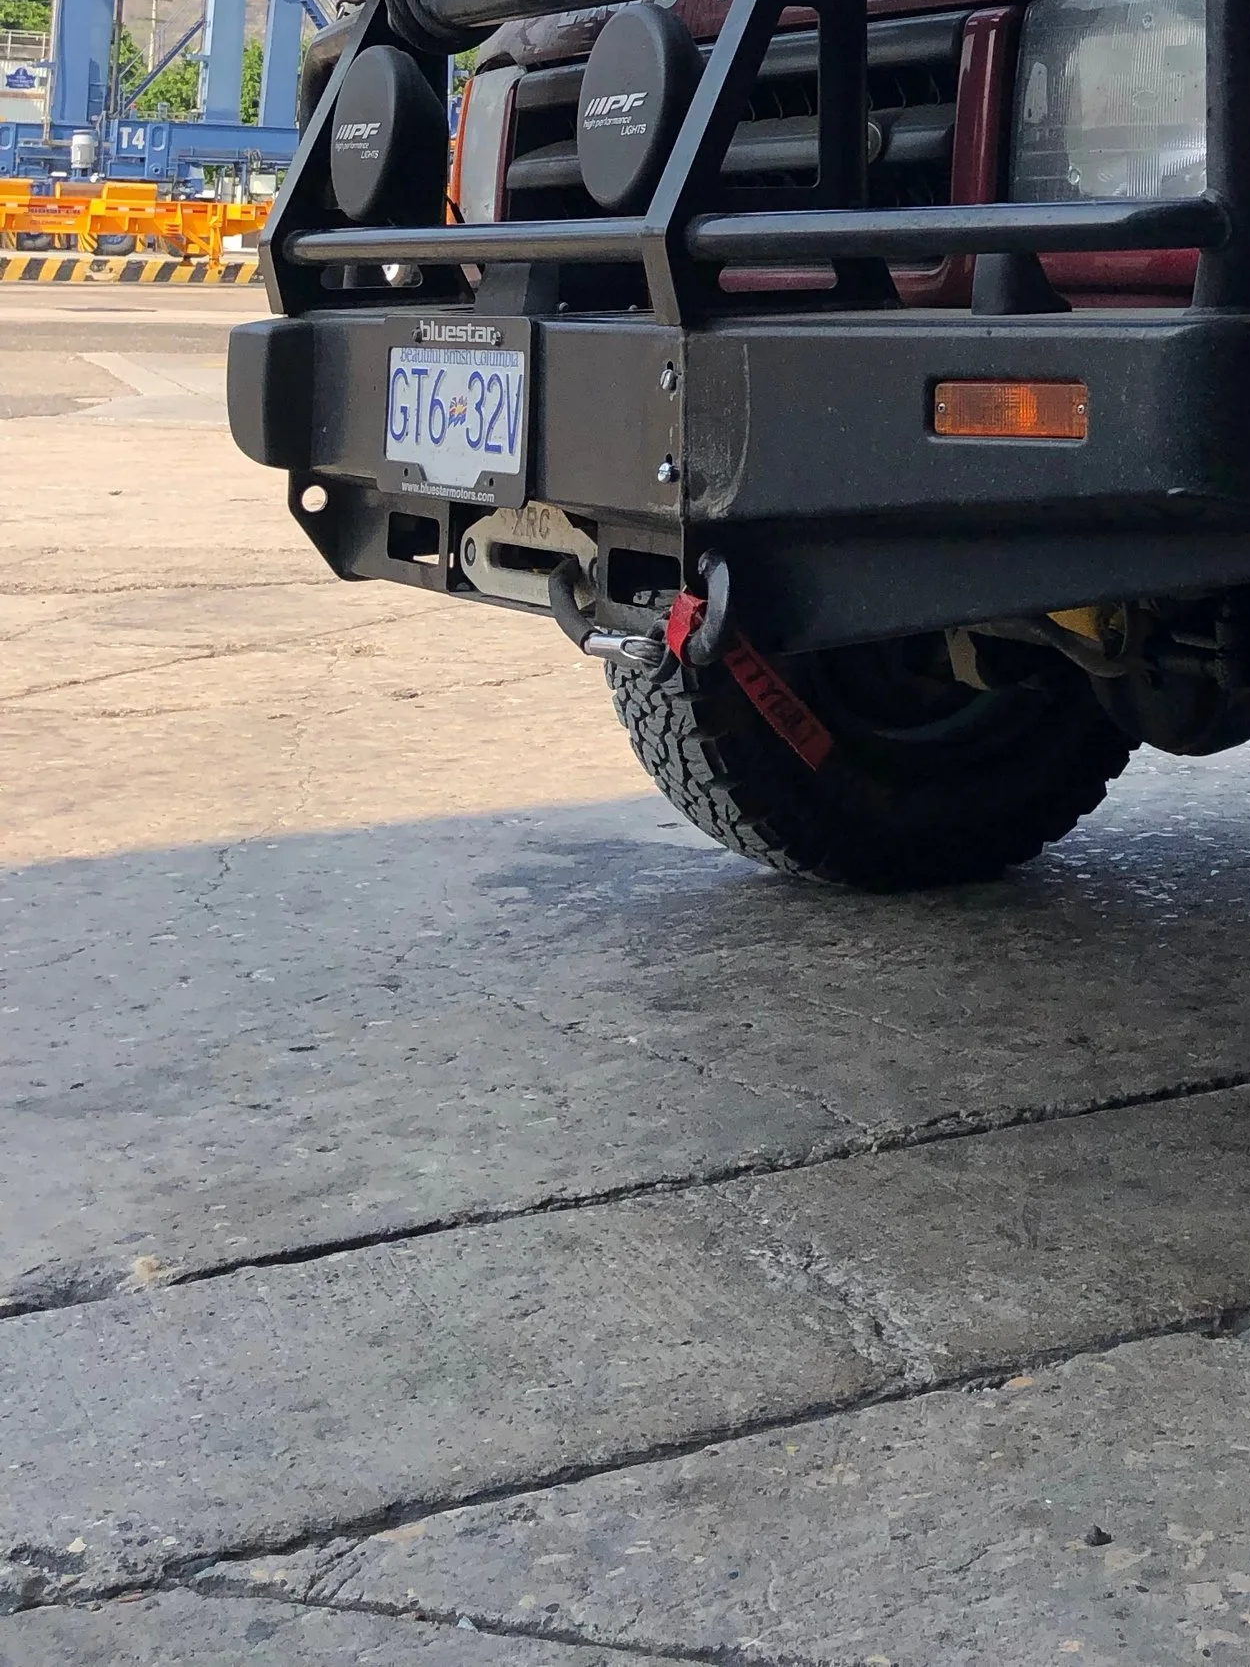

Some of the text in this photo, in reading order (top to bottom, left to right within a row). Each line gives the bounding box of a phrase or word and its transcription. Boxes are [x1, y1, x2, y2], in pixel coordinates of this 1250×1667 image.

[119, 126, 145, 150] T4
[620, 123, 647, 136] LIGHTS
[419, 319, 498, 345] bluestar
[474, 349, 519, 368] Columbia
[401, 481, 496, 503] www.bluestarmotors.com
